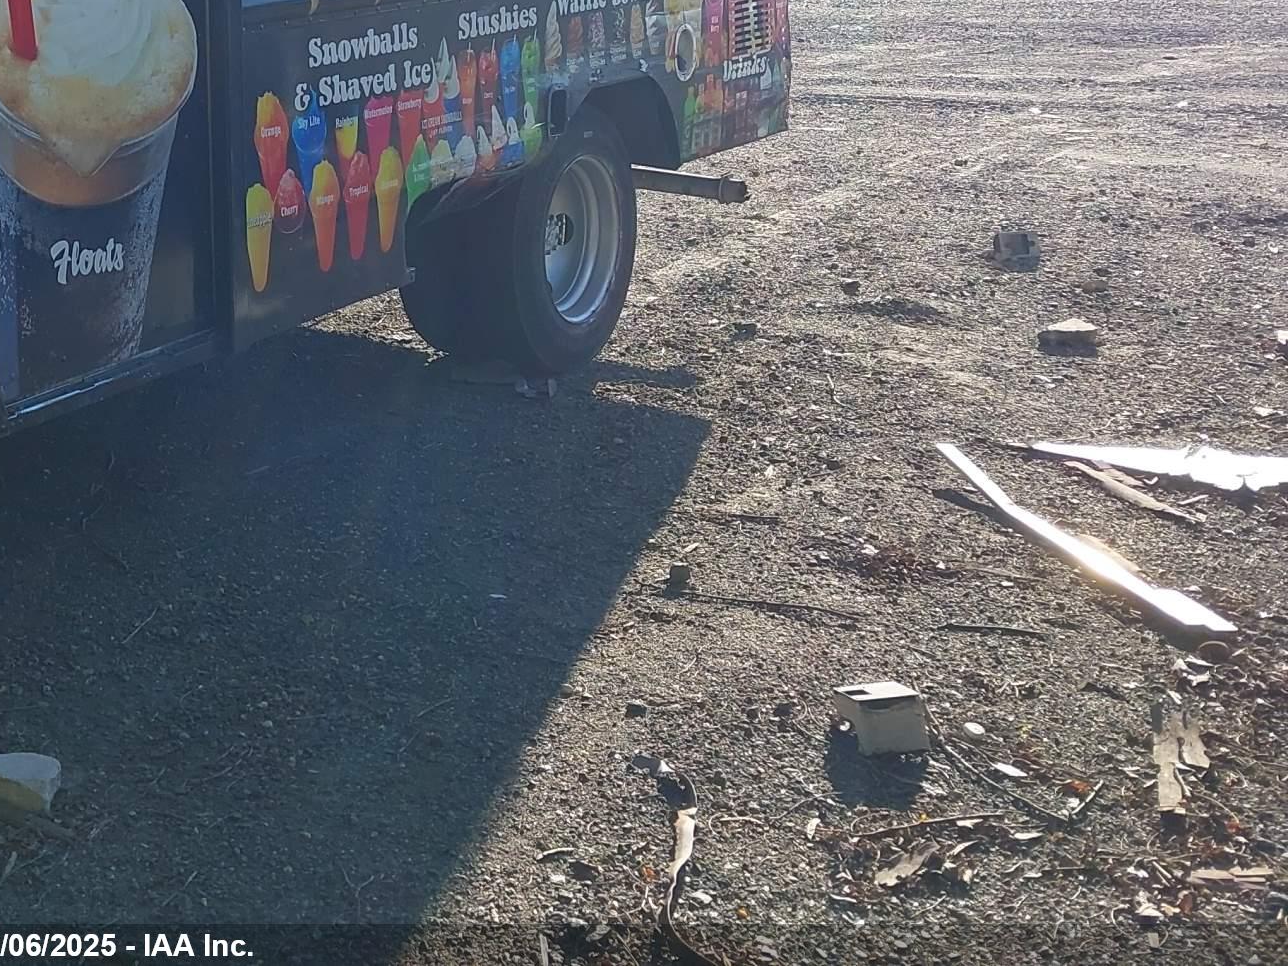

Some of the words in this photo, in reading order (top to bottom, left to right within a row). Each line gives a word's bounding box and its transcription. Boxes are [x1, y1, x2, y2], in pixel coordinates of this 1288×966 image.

[458, 4, 538, 42] Slushies
[308, 22, 419, 69] Snowballs
[294, 82, 311, 113] &
[319, 64, 398, 108] Shaved
[403, 59, 433, 89] Ice
[260, 125, 282, 139] Orange
[297, 117, 309, 131] Sky
[310, 115, 321, 128] Lite
[349, 183, 369, 198] Tropical
[280, 204, 299, 218] Cherry
[50, 237, 125, 285] Floats
